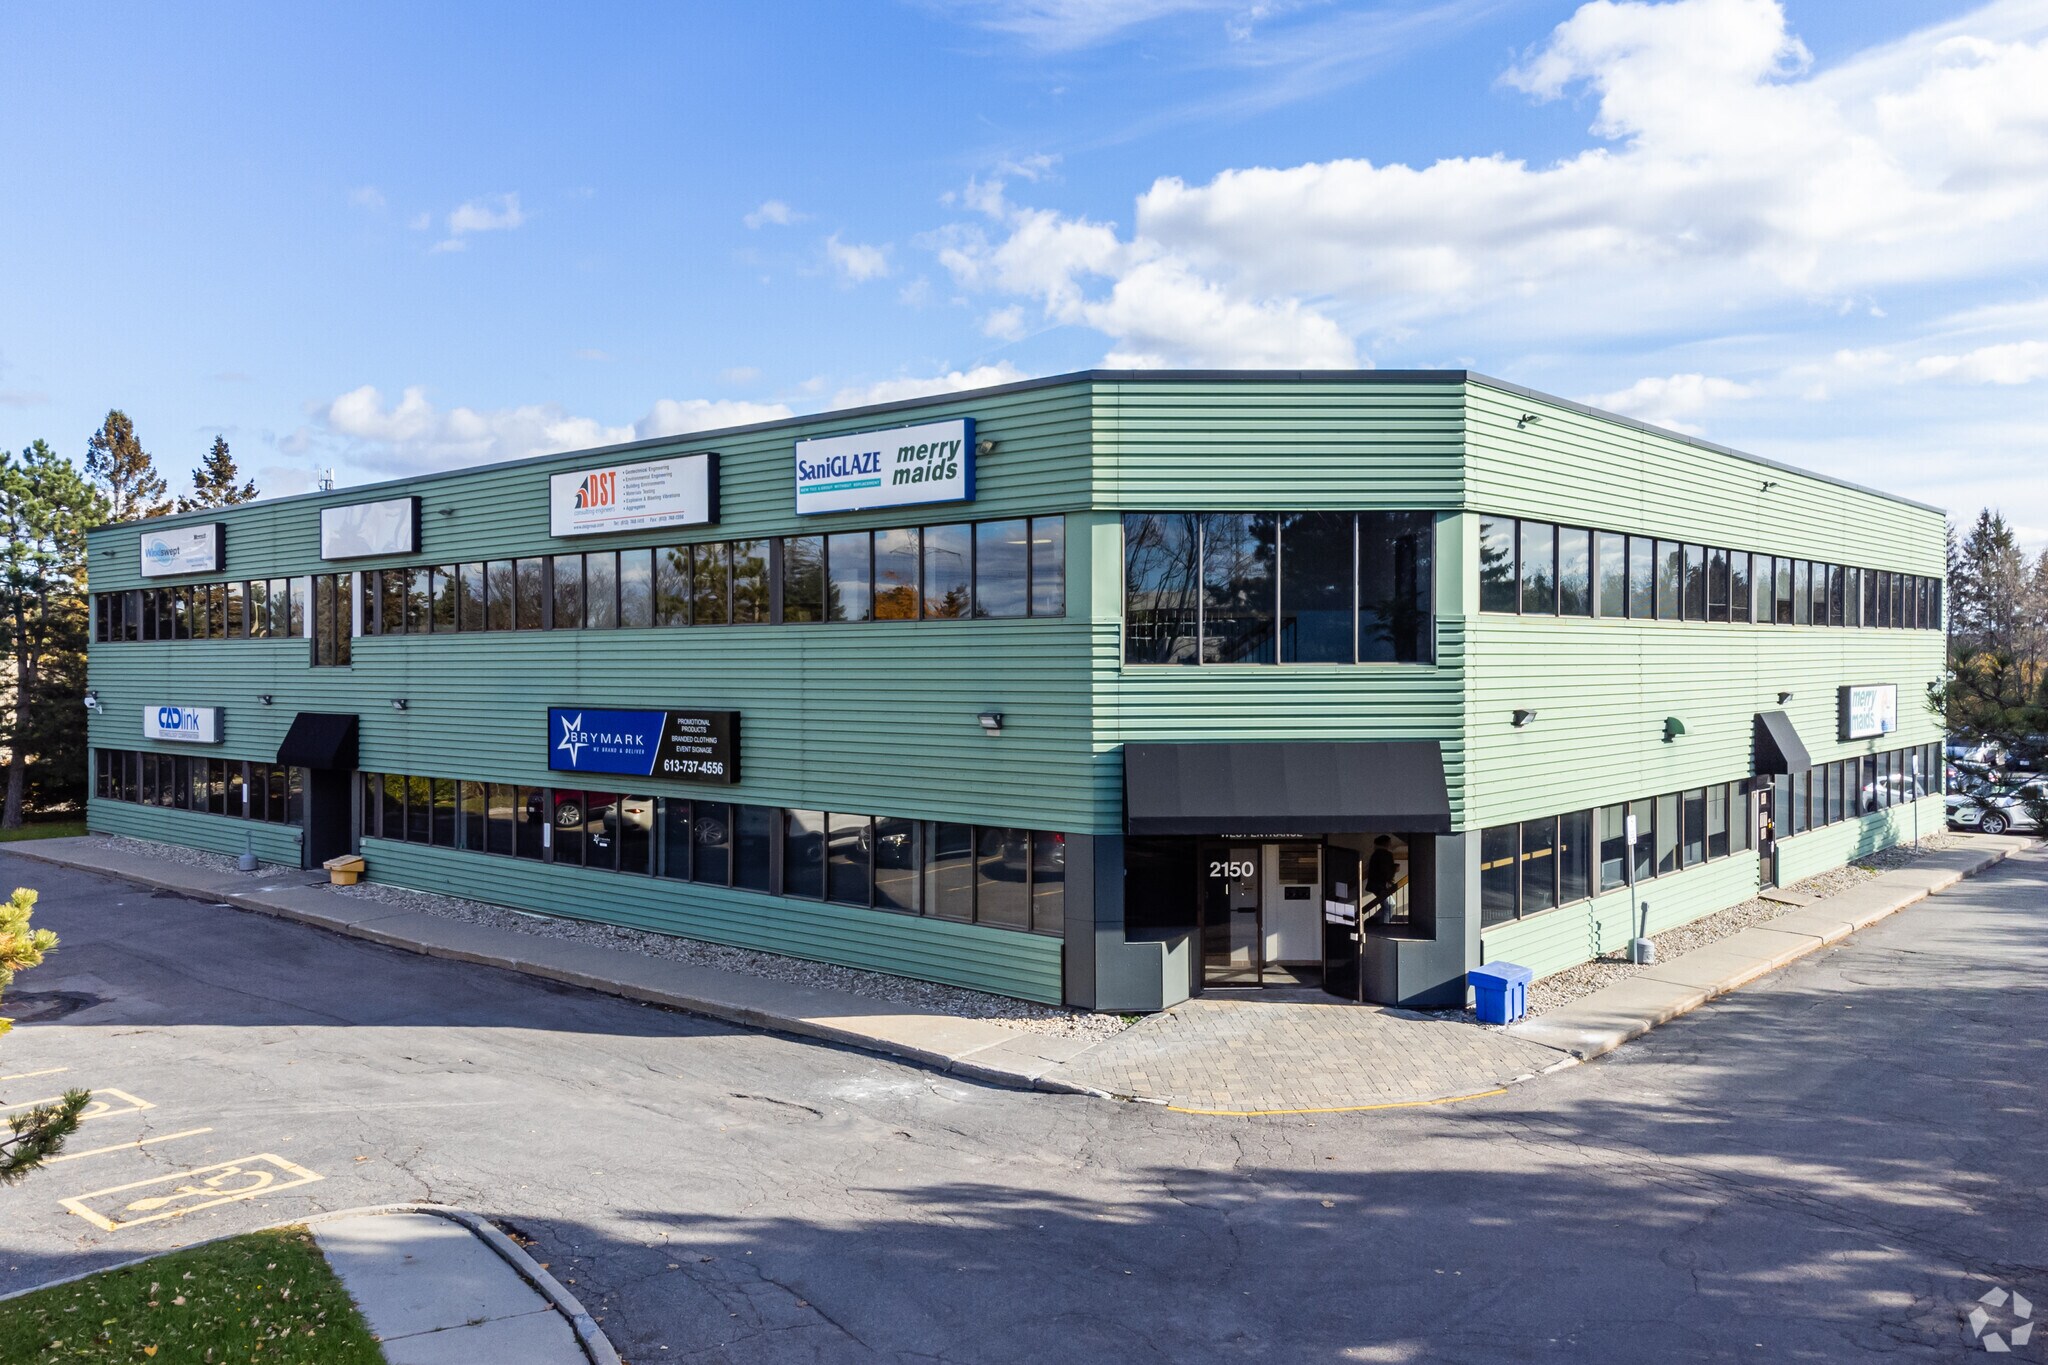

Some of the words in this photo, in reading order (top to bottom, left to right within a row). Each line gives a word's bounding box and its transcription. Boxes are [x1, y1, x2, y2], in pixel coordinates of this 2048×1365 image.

[896, 439, 962, 463] merry
[798, 451, 882, 481] SaniGLAZE
[892, 458, 958, 485] maids
[590, 471, 616, 507] DST
[1852, 690, 1878, 711] merry
[158, 706, 200, 730] CADlink
[677, 718, 711, 726] PROMOTIONAL
[1851, 706, 1876, 731] maids
[570, 731, 644, 746] BRYMARK
[681, 725, 707, 733] PRODUCTS
[671, 735, 694, 743] BRANDED
[693, 736, 718, 744] CLOTHING
[691, 746, 713, 754] SIGNAGE
[663, 758, 724, 775] 613-737-4556
[1209, 861, 1255, 878] 2150
